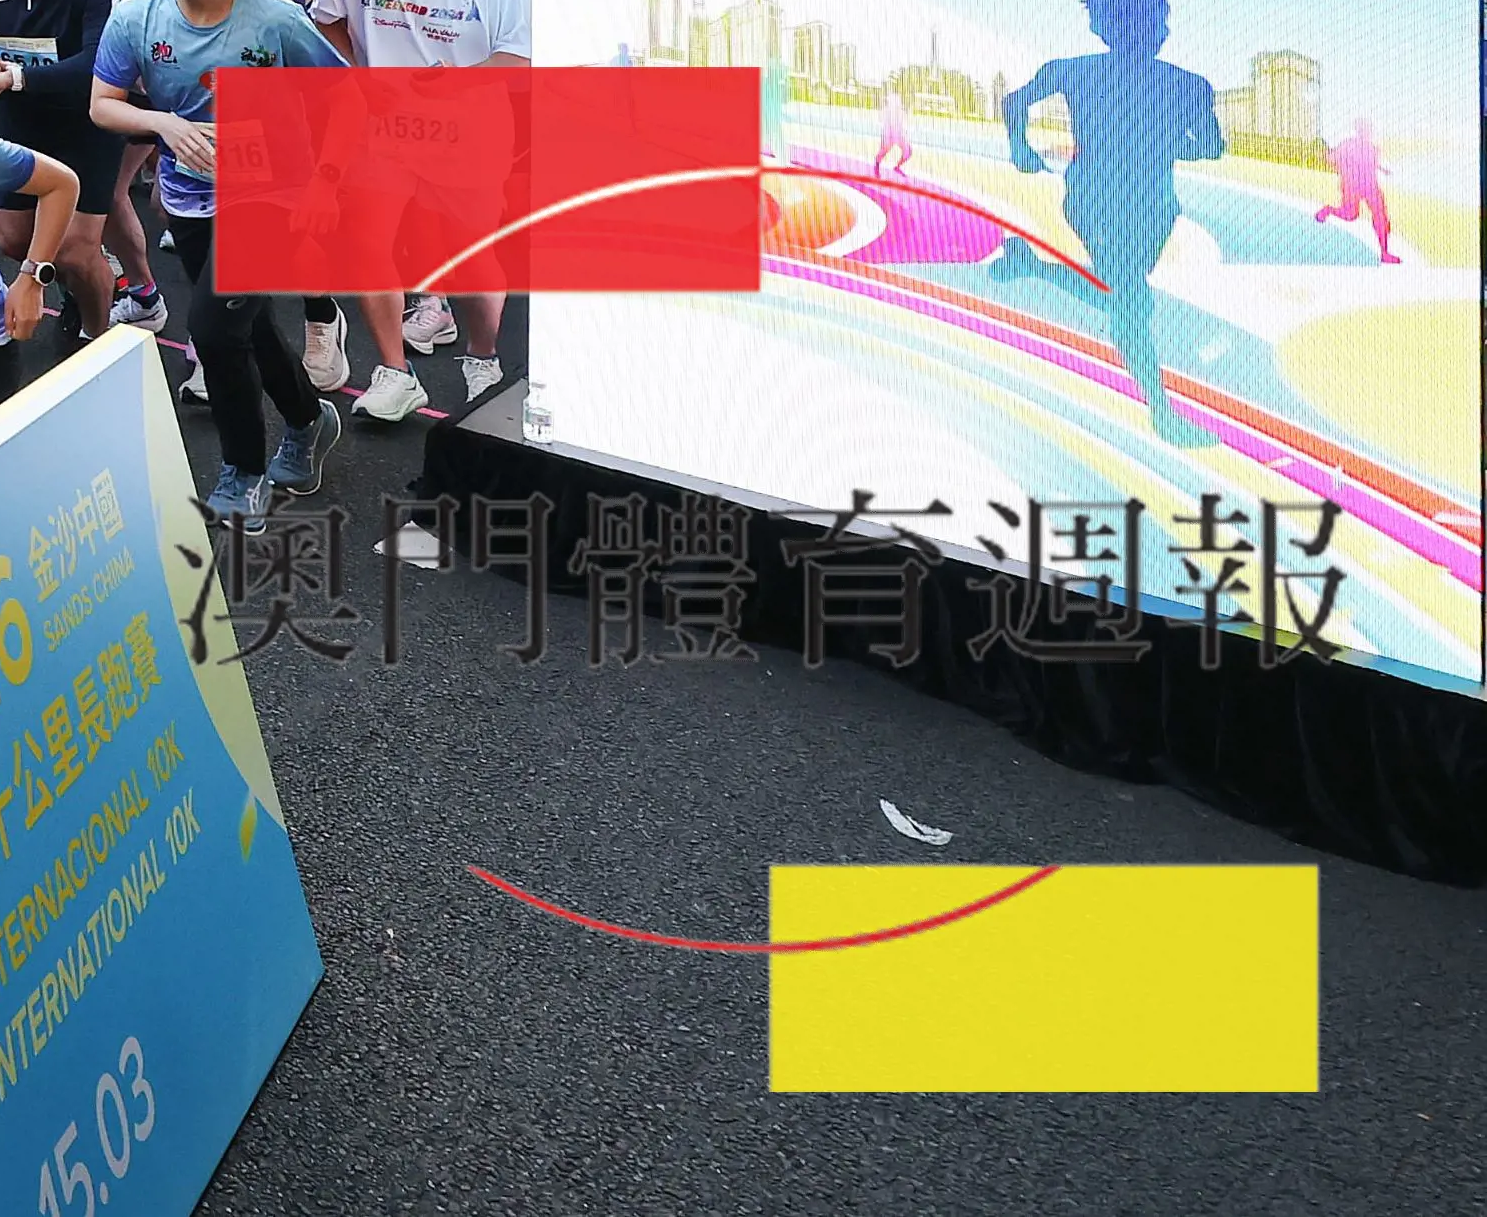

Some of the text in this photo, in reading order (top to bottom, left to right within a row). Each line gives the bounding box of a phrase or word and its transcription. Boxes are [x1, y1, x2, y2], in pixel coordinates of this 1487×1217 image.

[28, 467, 124, 603] 金沙中國
[43, 545, 136, 653] SANDS CHINA
[146, 720, 185, 791] 10K
[164, 787, 202, 868] 10K
[38, 1035, 157, 1217] 15.03
